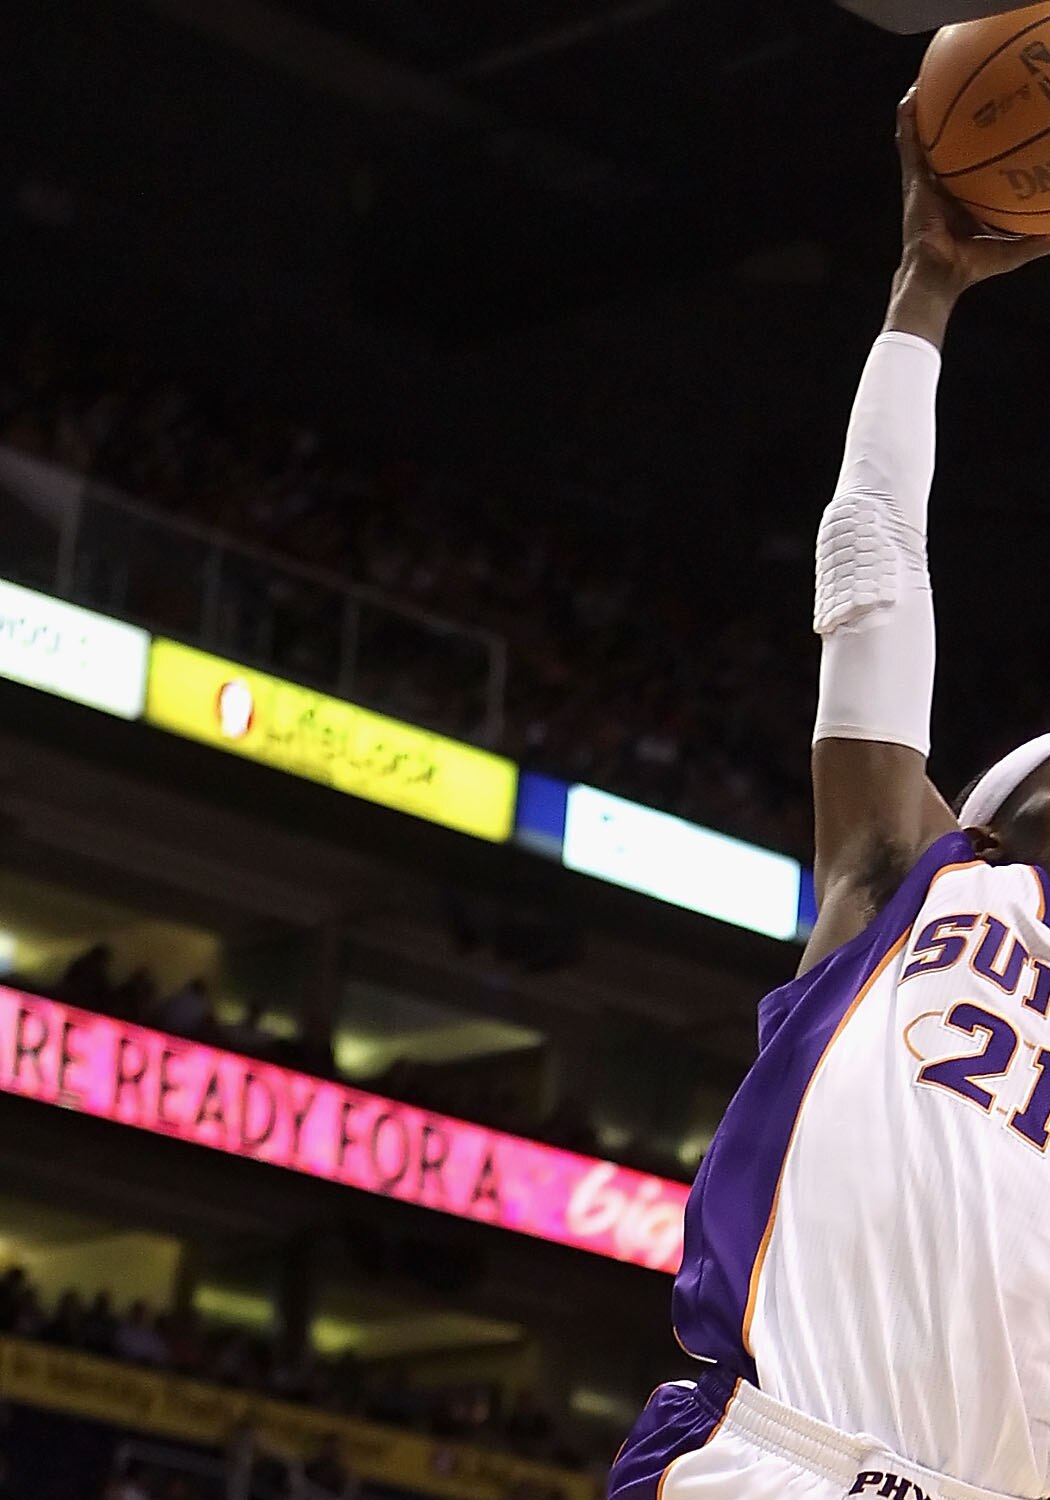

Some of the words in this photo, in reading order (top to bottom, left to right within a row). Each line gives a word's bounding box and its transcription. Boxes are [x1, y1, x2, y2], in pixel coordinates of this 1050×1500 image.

[115, 1036, 316, 1158] READY
[338, 1100, 449, 1198] FOR
[468, 1144, 503, 1214] A
